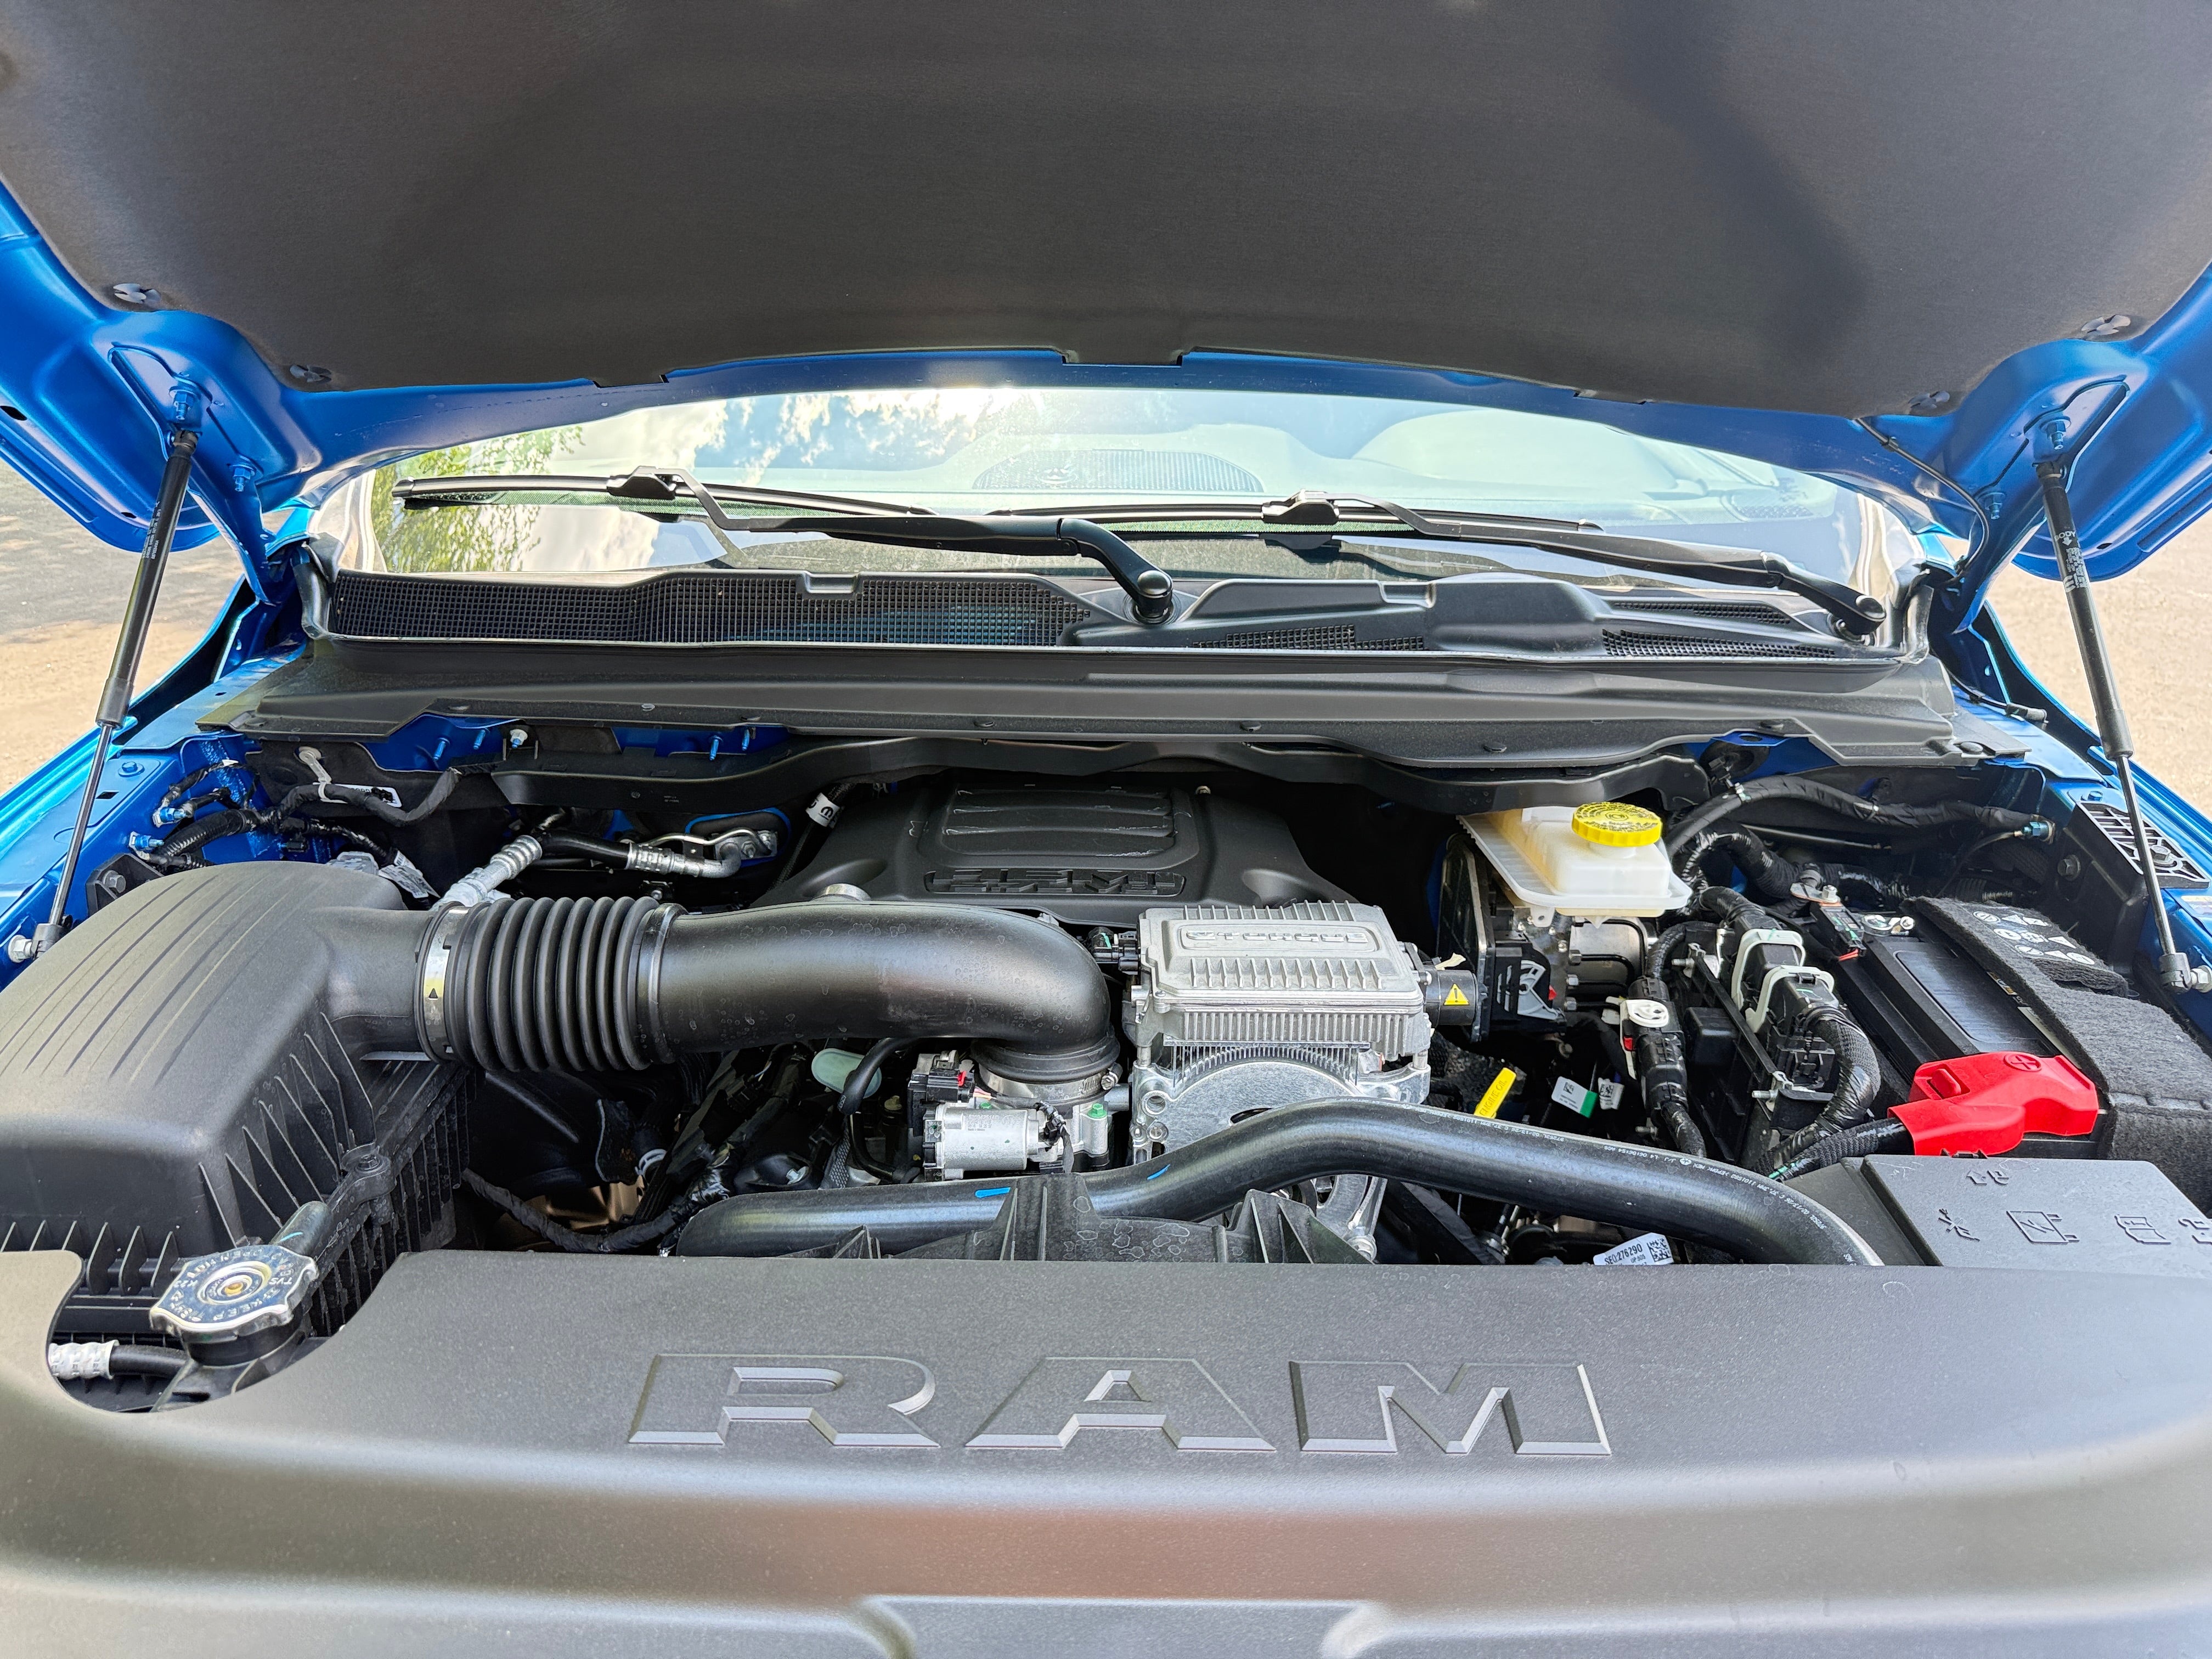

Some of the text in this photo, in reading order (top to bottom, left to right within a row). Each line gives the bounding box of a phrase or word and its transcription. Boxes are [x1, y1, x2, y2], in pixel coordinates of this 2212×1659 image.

[2055, 531, 2076, 542] BODY
[1479, 1090, 1499, 1116] ENGINE
[268, 1277, 293, 1285] TVS
[628, 1354, 1612, 1456] RAM
